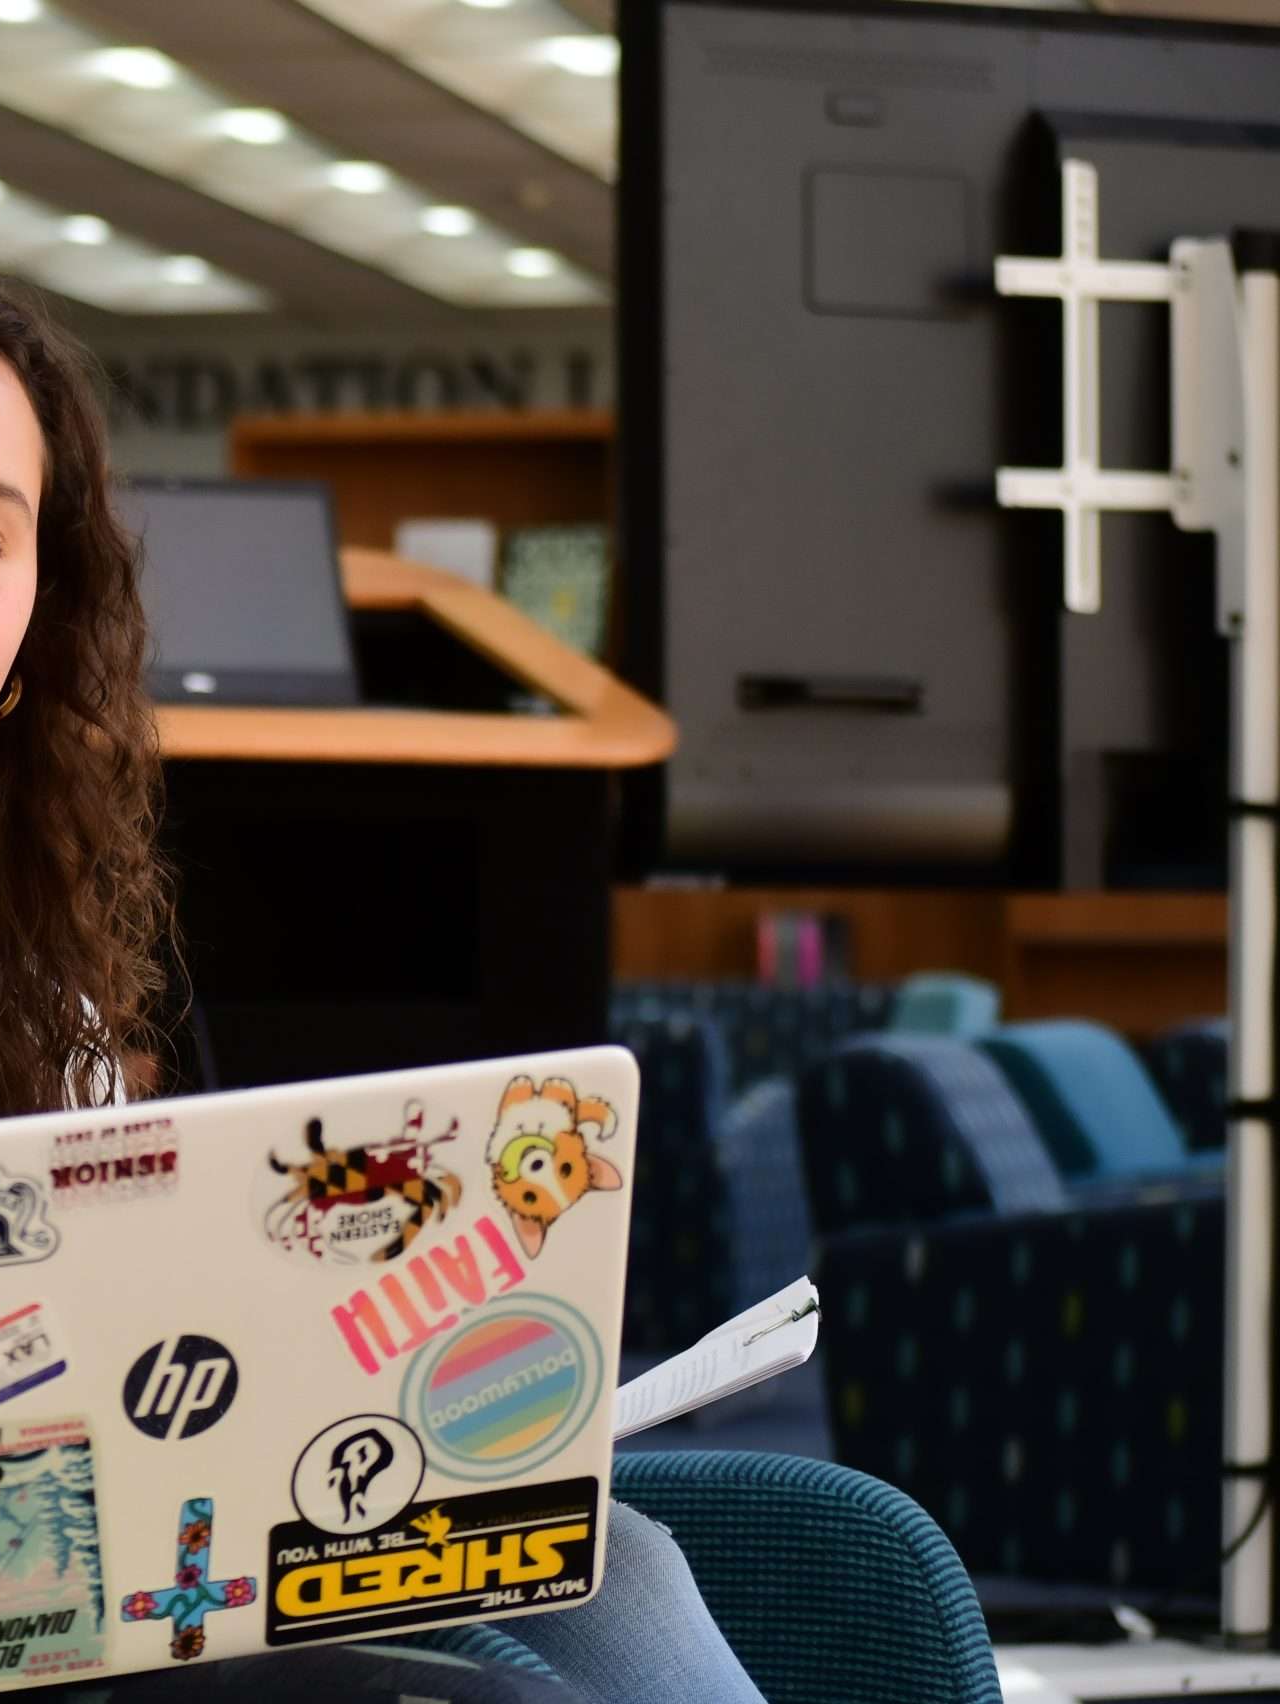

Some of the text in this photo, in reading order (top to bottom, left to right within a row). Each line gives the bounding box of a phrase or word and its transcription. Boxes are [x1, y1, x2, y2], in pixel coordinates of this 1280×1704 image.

[329, 1219, 401, 1244] EASTERN
[337, 1207, 392, 1228] SHORE
[3, 1332, 52, 1365] LAX
[133, 1336, 231, 1440] hp
[429, 1347, 576, 1430] DOLLYWOOD
[276, 1530, 406, 1566] BE WITH YOU
[275, 1523, 589, 1618] SHRED
[480, 1577, 588, 1609] MAY THE
